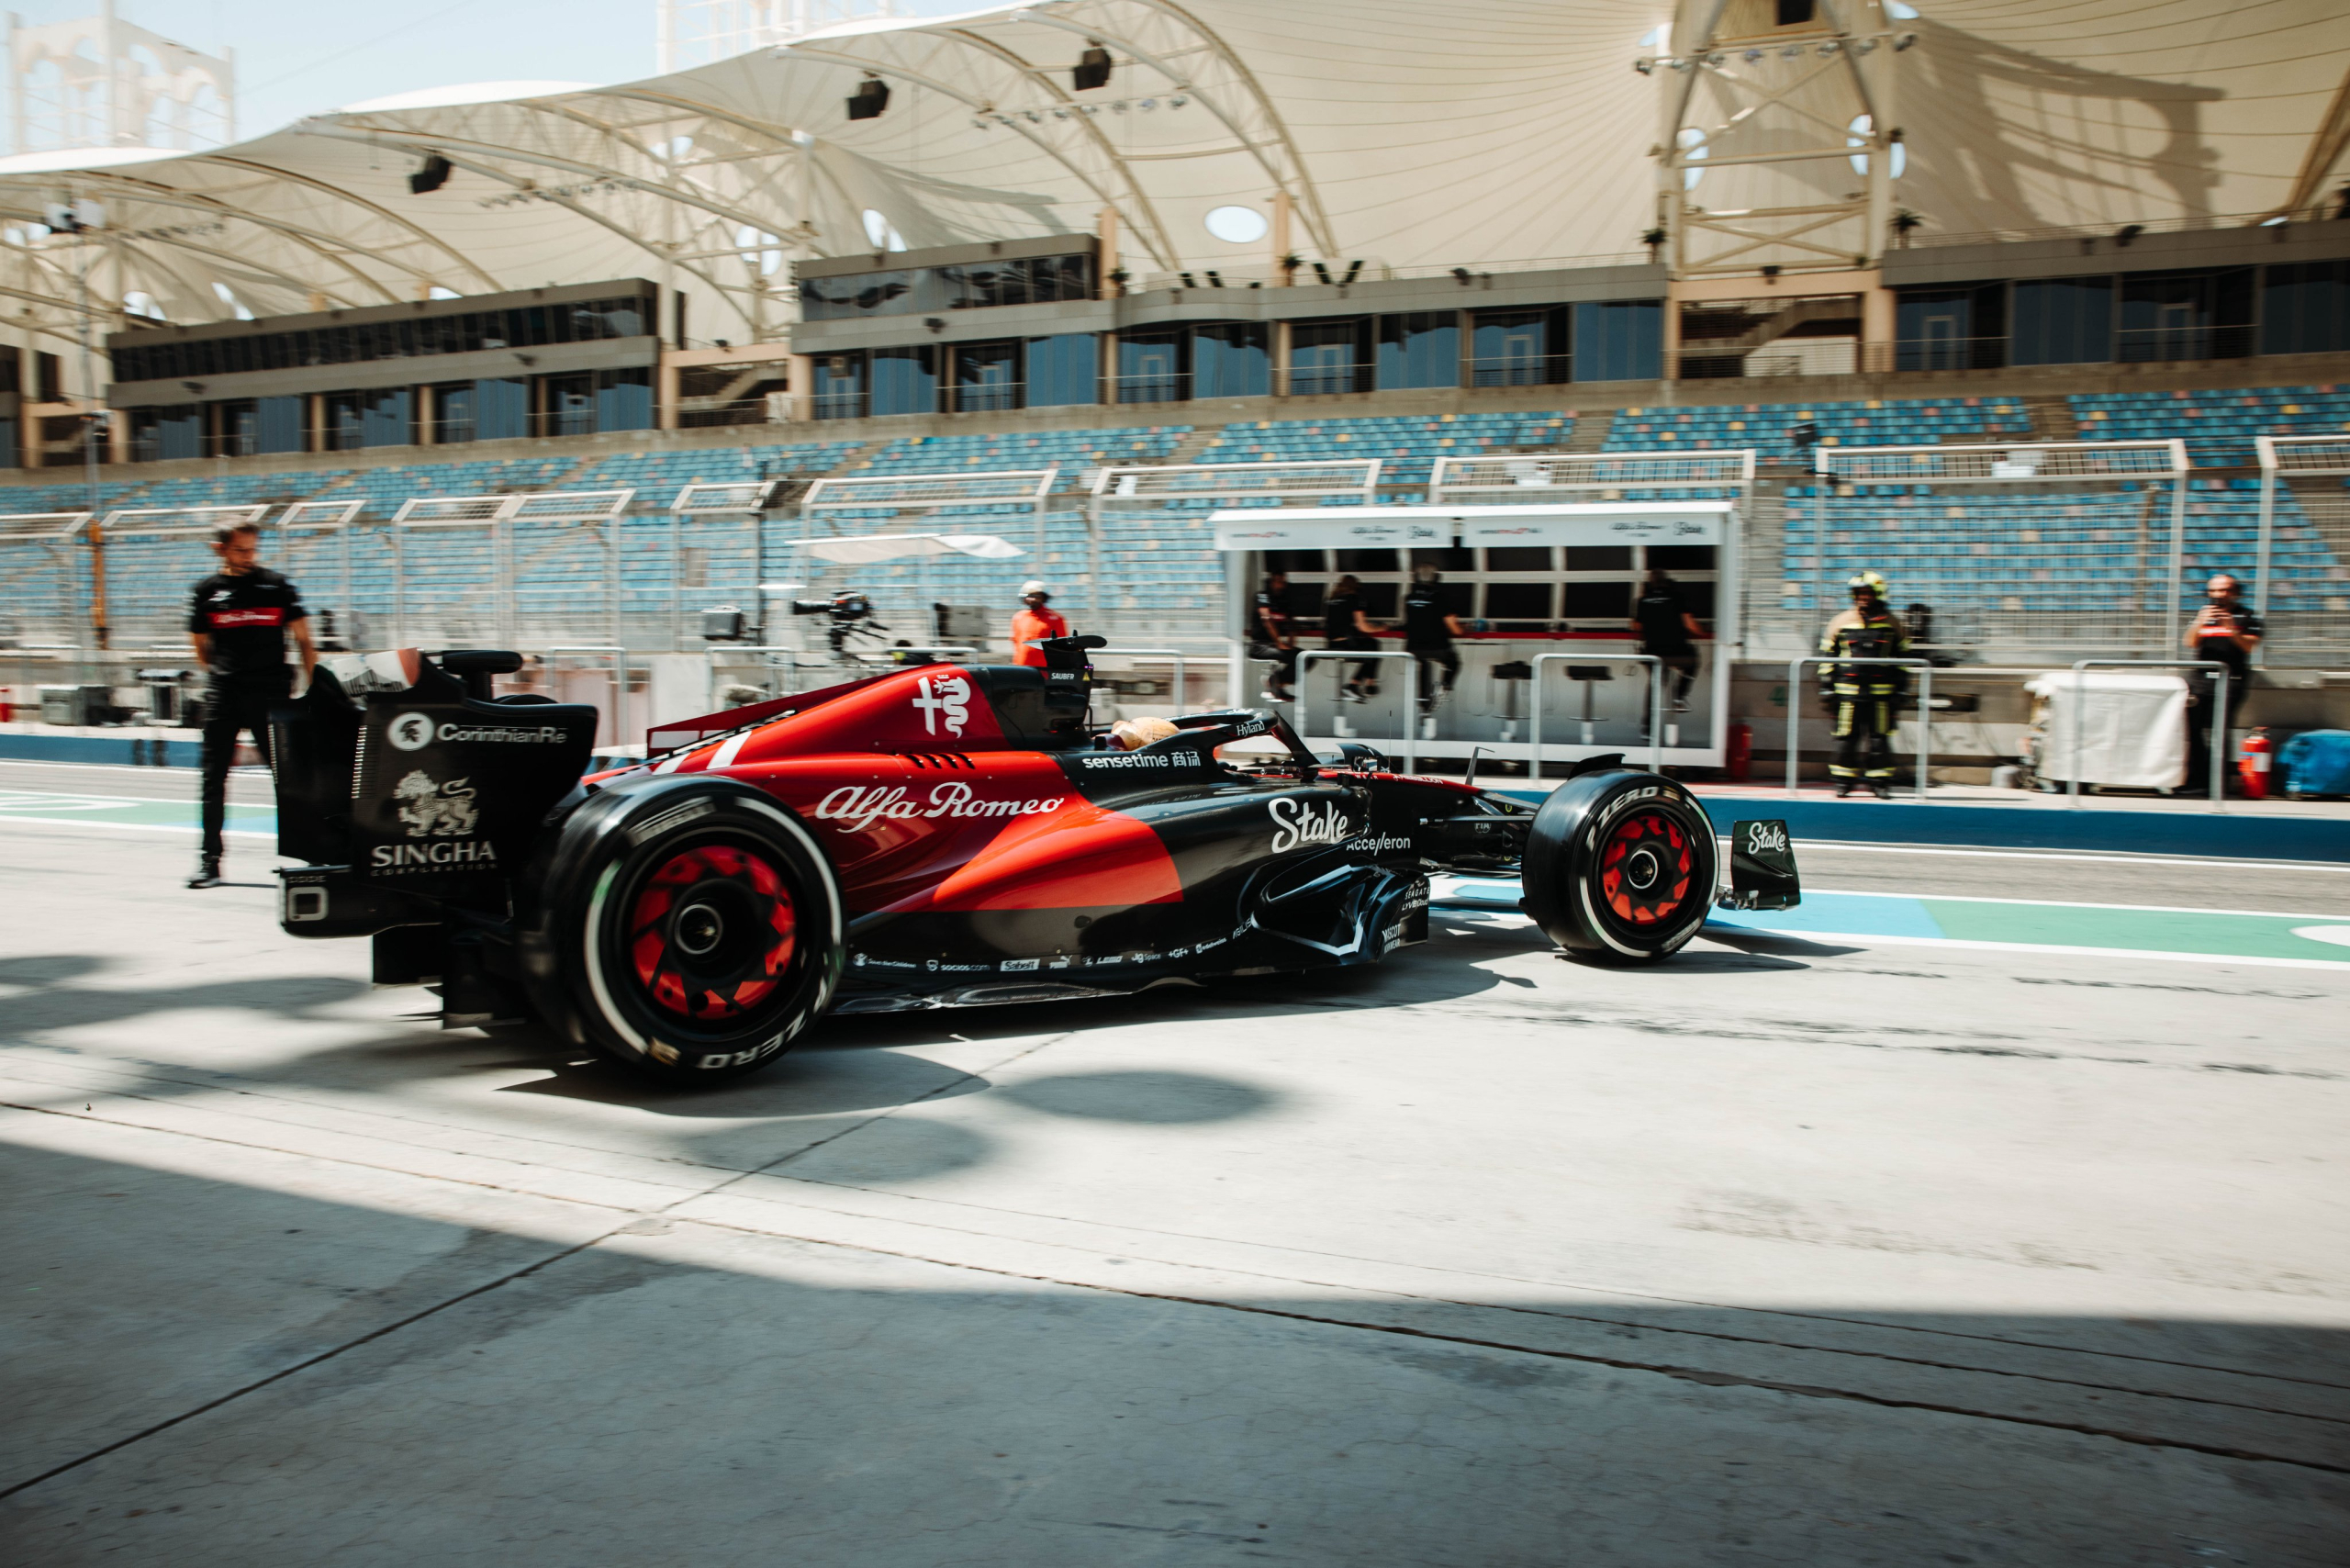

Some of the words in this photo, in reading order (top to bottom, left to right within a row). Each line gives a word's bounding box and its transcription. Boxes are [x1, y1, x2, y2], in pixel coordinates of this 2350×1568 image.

[1051, 672, 1074, 680] SAUBER
[1237, 721, 1265, 737] Hyland
[1082, 754, 1169, 768] sensetime
[814, 786, 923, 834] Alfa
[923, 781, 1065, 819] Romeo
[1597, 786, 1659, 829] ZERO
[1268, 797, 1348, 854] Stake
[1748, 822, 1786, 855] Stake
[371, 840, 498, 867] SINGHA
[1346, 832, 1411, 857] Accelleron
[1404, 887, 1430, 900] SEAGATE
[696, 1008, 808, 1070] ZERO
